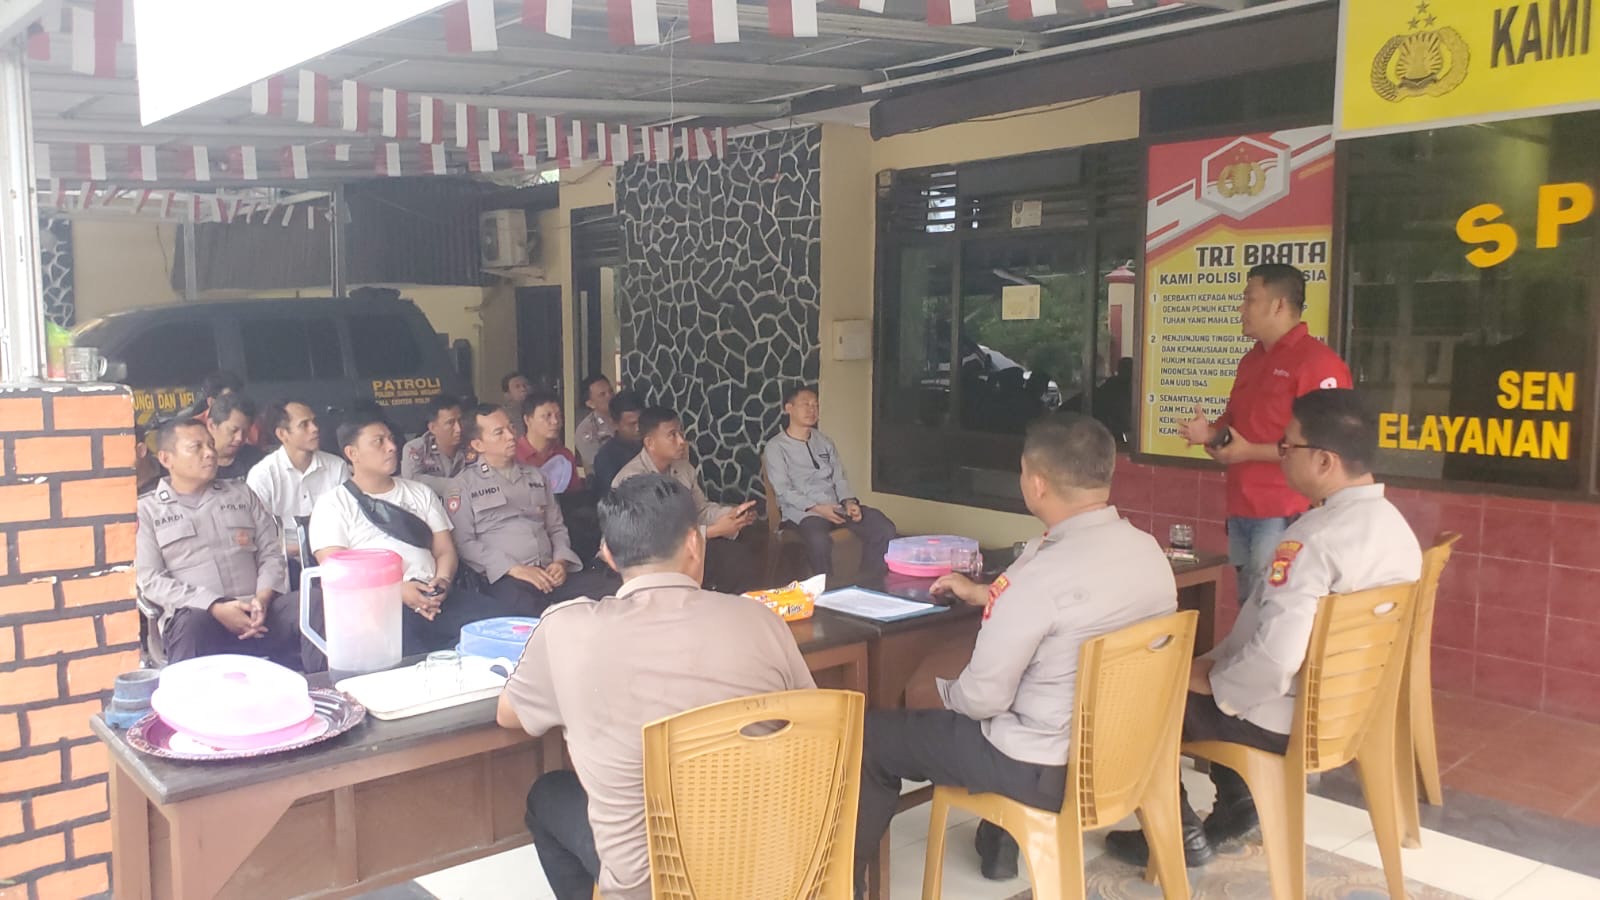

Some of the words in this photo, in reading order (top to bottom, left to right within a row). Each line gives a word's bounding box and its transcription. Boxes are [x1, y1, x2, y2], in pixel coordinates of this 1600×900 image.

[1490, 0, 1592, 69] KAMI
[1196, 245, 1235, 267] TRI
[1244, 241, 1327, 266] BRATA
[1160, 273, 1193, 285] KAMI
[1198, 271, 1241, 284] POLISI
[1162, 294, 1197, 303] BERBAKTI
[1198, 293, 1226, 302] KEPADA
[1162, 305, 1191, 313] DENGAN
[1192, 305, 1217, 313] PENUH
[1162, 316, 1186, 324] TUHAN
[1187, 316, 1206, 324] YANG
[1207, 316, 1229, 324] MAHA
[1162, 334, 1210, 343] MENJUNJUNG
[1211, 335, 1235, 343] TINGGI
[1161, 345, 1176, 353] DAN
[1177, 346, 1228, 354] KEMANUSIAAN
[1161, 357, 1186, 365] HUKUM
[1187, 358, 1216, 366] NEGARA
[1160, 367, 1197, 376] INDONESIA
[1199, 368, 1218, 377] YANG
[372, 377, 441, 391] PATROLI
[1160, 378, 1175, 386] DAN
[1176, 379, 1191, 387] UUD
[1192, 379, 1208, 388] 1945
[1497, 370, 1575, 411] SEN
[1159, 394, 1203, 403] SENANTIASA
[1159, 405, 1174, 413] DAN
